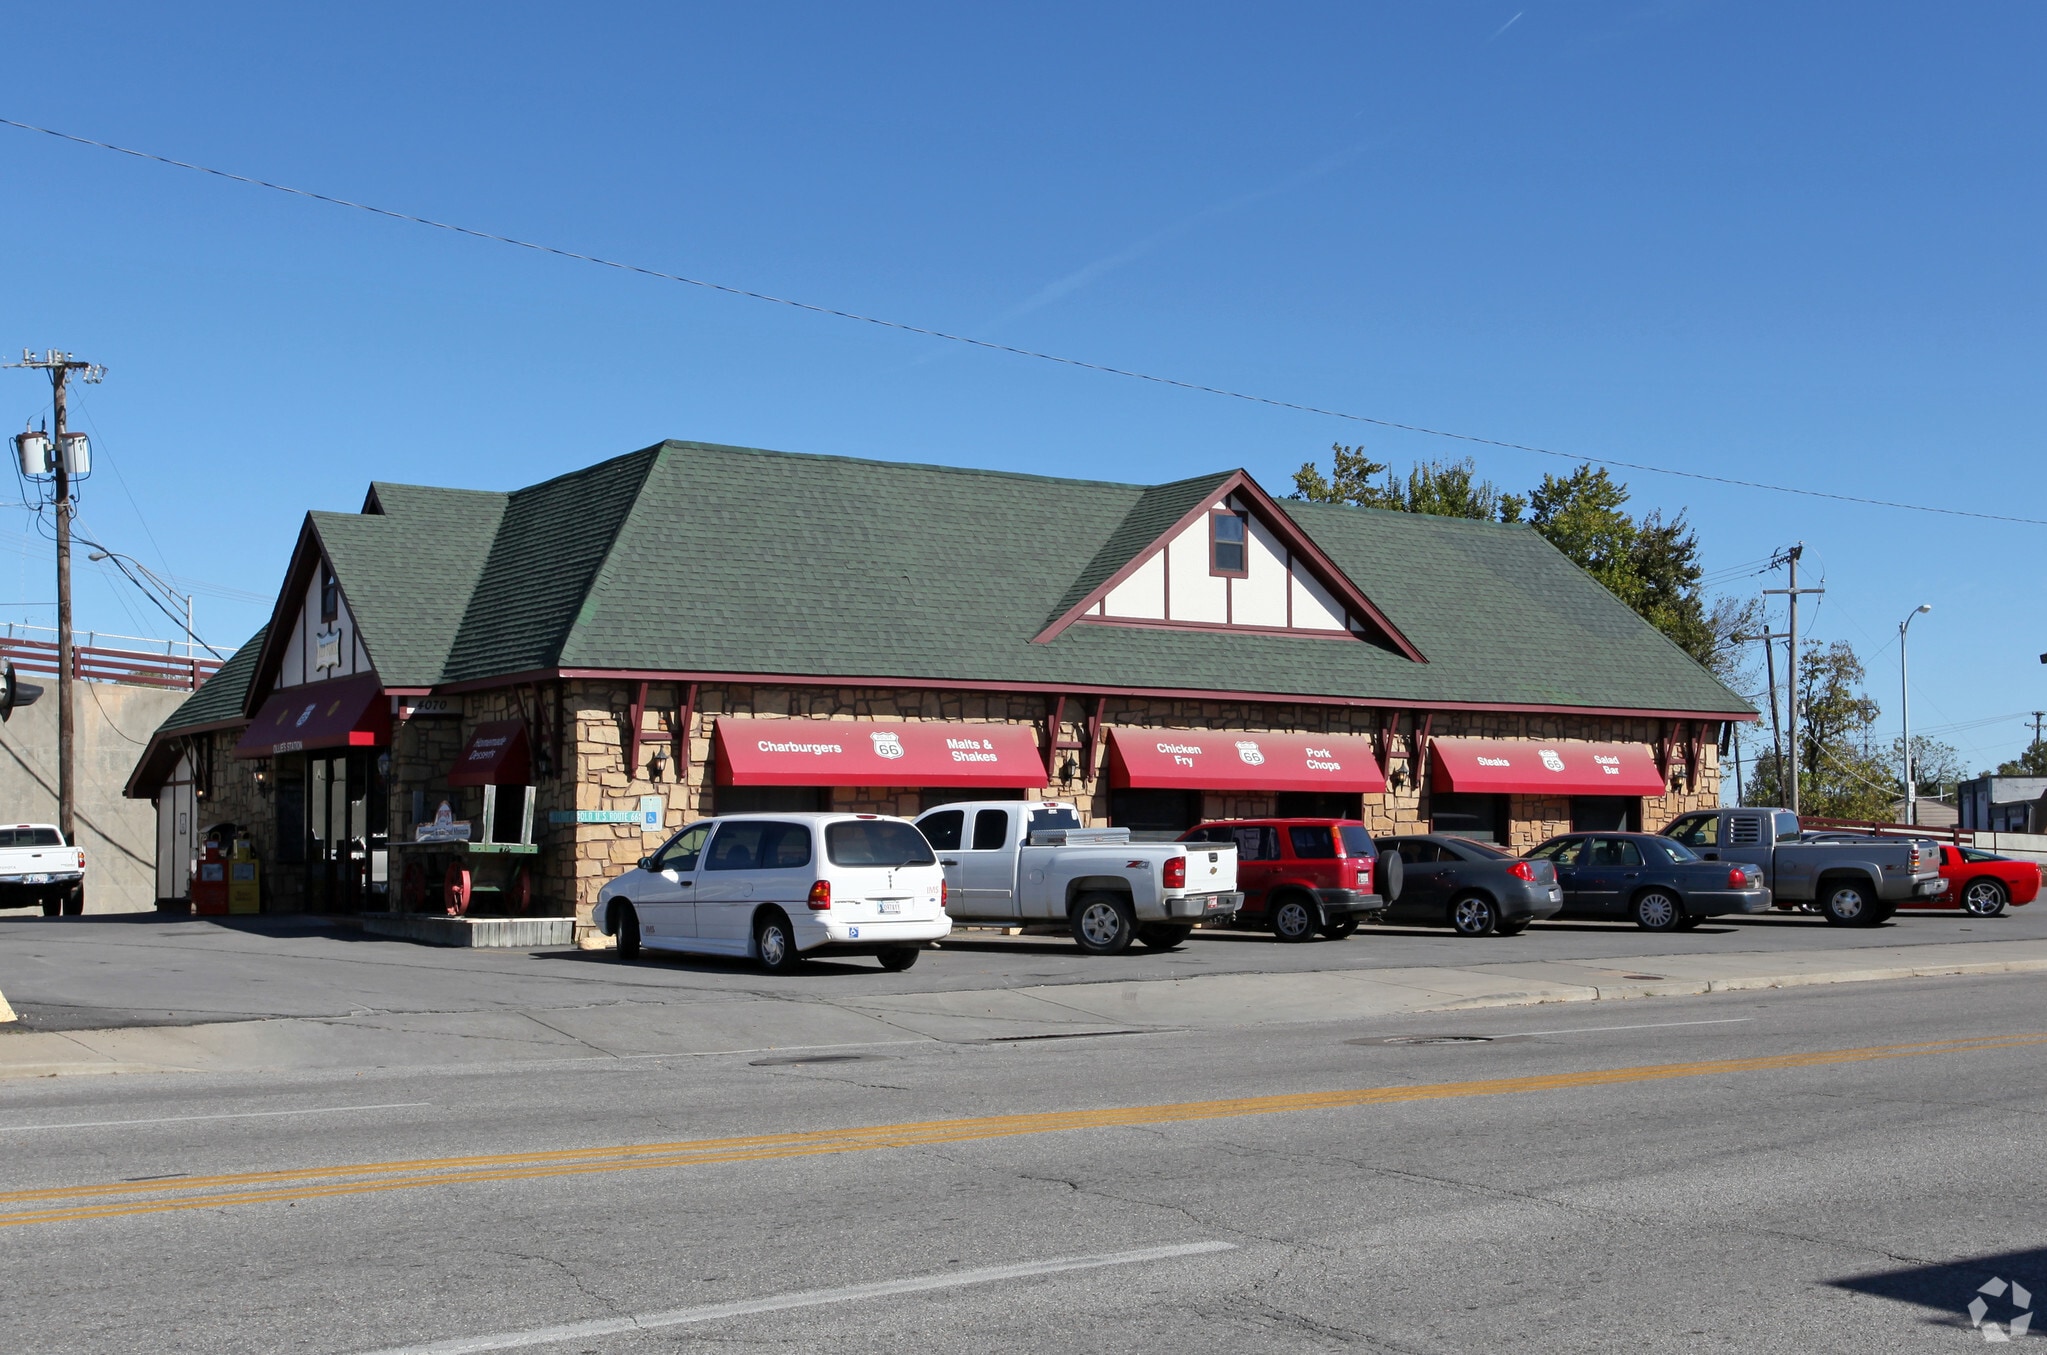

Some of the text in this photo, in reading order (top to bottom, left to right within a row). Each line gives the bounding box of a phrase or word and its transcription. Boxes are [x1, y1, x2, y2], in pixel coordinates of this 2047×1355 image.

[417, 700, 447, 710] 4070
[757, 740, 843, 755] Charburgers
[879, 744, 899, 755] 66
[946, 738, 993, 750] Malts &
[1156, 743, 1202, 754] Chicken
[468, 749, 496, 760] Desserts
[951, 750, 998, 762] Shakes
[1243, 752, 1261, 762] 66
[1305, 747, 1332, 758] Pork
[1174, 755, 1194, 768] Fry
[1306, 759, 1341, 772] Chops
[1477, 756, 1510, 767] Steaks
[1546, 759, 1561, 769] 66
[1593, 755, 1620, 765] Salad
[1602, 765, 1619, 775] Bar
[580, 811, 593, 821] OLD
[609, 811, 627, 821] ROUTE
